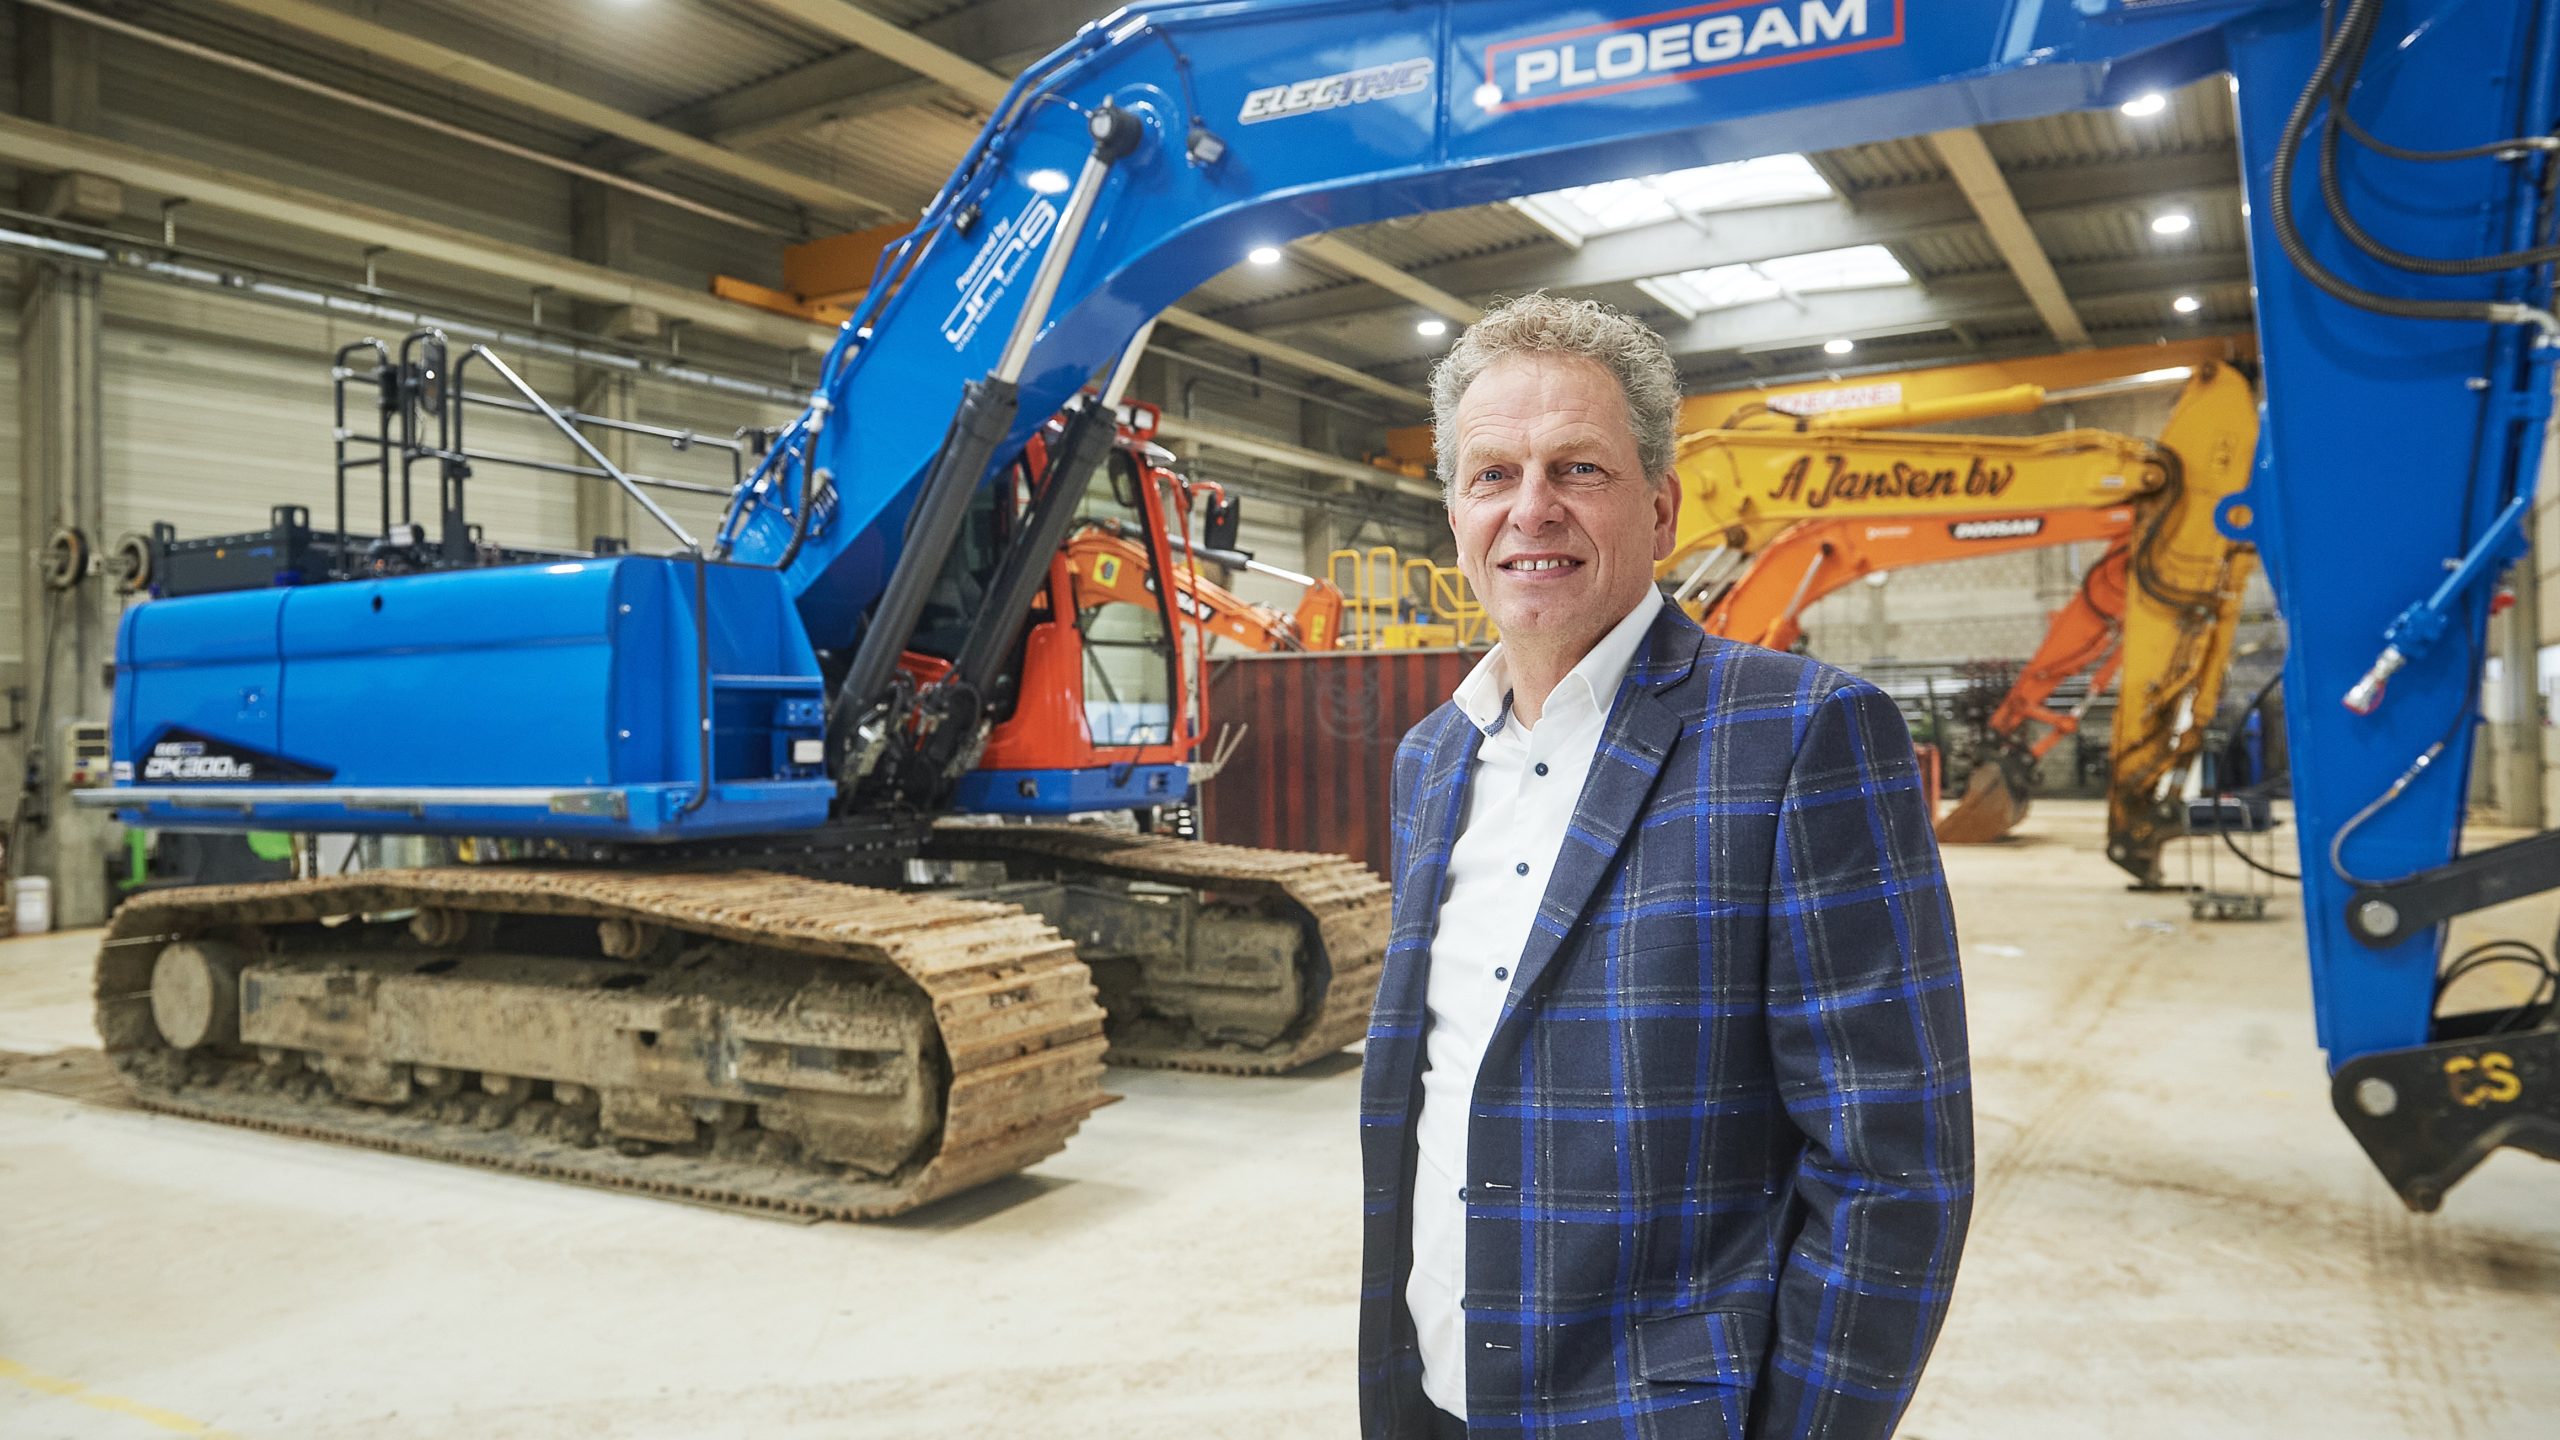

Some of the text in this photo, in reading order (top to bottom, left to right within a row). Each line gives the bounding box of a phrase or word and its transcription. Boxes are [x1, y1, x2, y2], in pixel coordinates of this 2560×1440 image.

[1515, 0, 1867, 94] PLOEGAM
[1239, 57, 1434, 125] ELECTRIC
[956, 216, 1010, 292] Powered by
[1768, 455, 1811, 499] A
[1965, 456, 2015, 497] bv
[1954, 518, 2040, 539] DOOSAN
[2444, 1051, 2522, 1107] CS
